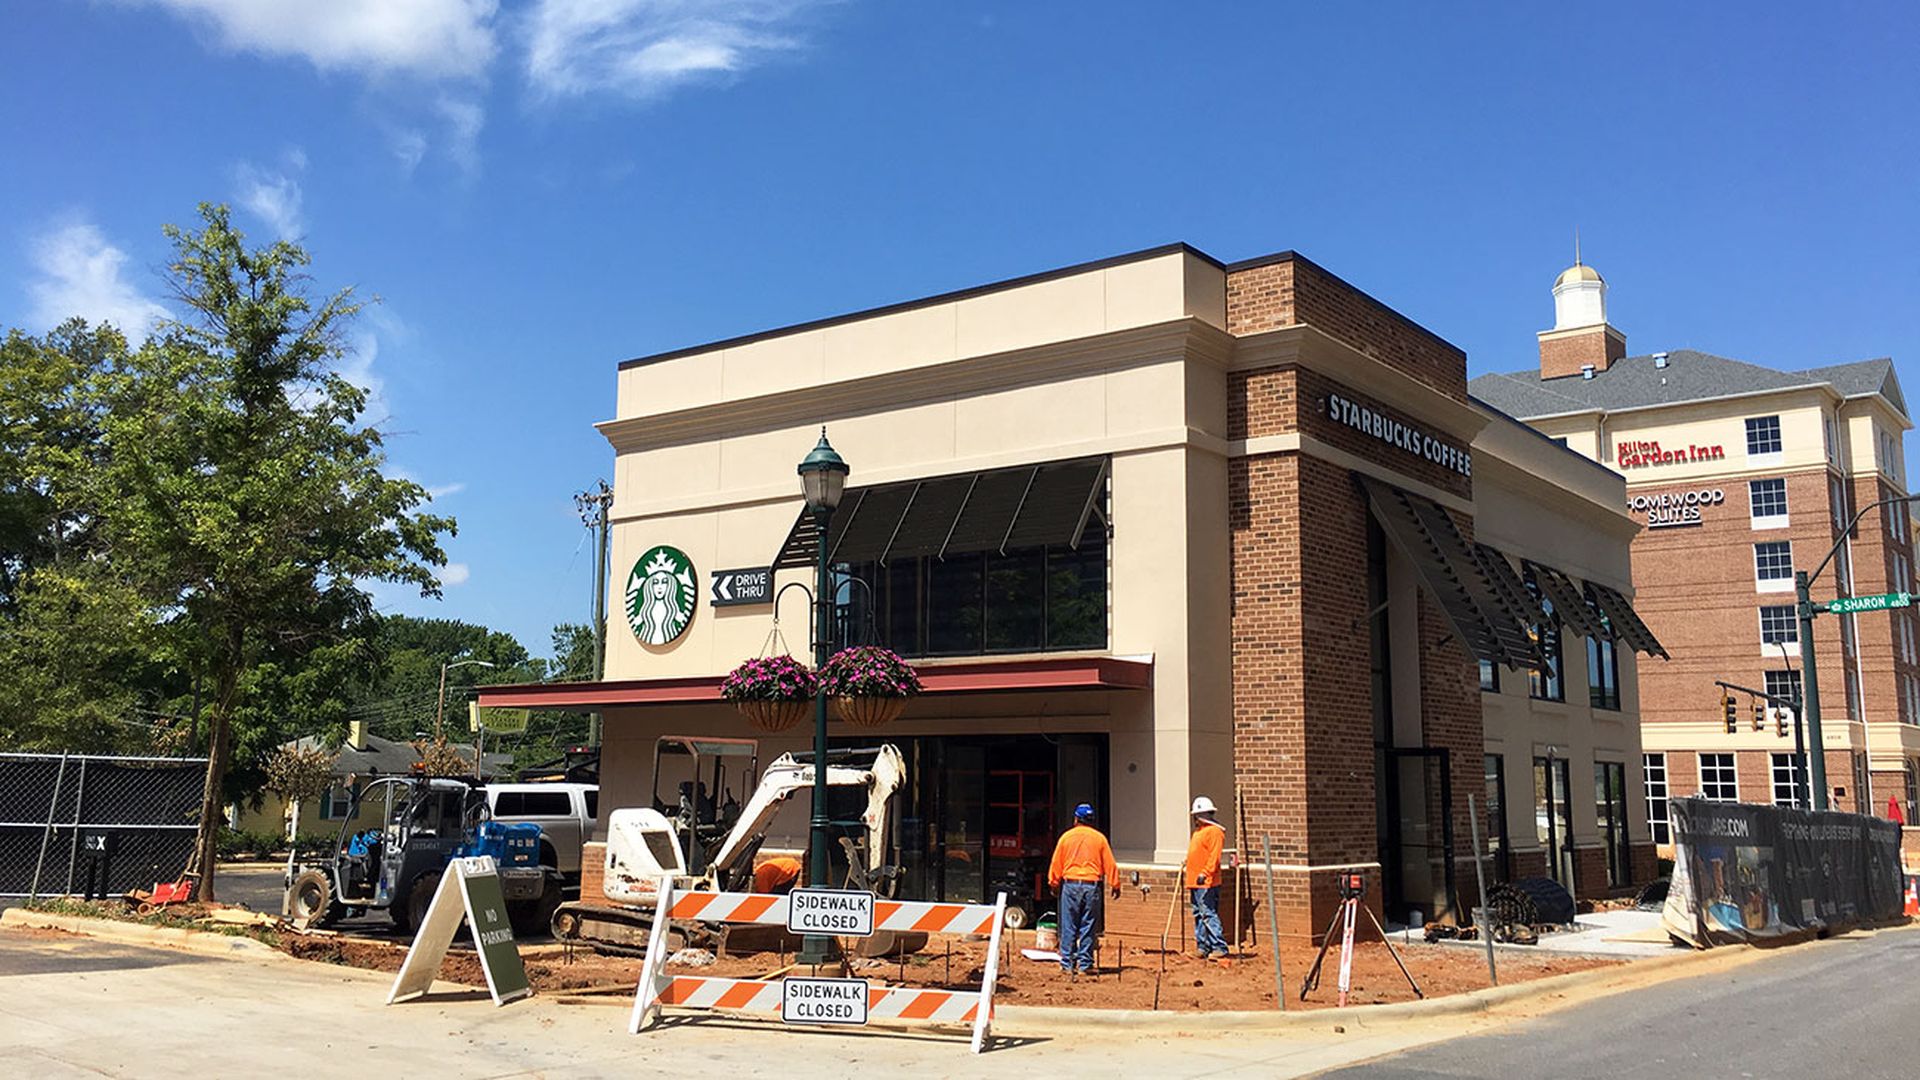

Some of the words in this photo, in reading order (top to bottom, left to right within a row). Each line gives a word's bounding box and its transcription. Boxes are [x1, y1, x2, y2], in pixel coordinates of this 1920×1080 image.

[1330, 394, 1421, 455] STARBUCKS
[1423, 436, 1472, 477] COFFEE
[1618, 448, 1687, 468] Garden
[1689, 444, 1724, 460] Inn
[1648, 507, 1700, 523] SUITES
[736, 573, 766, 586] DRIVE
[736, 586, 764, 598] THRU
[1844, 597, 1886, 611] SHARON
[796, 895, 867, 911] SIDEWALK
[485, 908, 498, 922] NO
[803, 914, 859, 929] CLOSED
[481, 928, 513, 946] PARKING
[790, 984, 861, 1000] SIDEWALK
[797, 1003, 853, 1018] CLOSED
